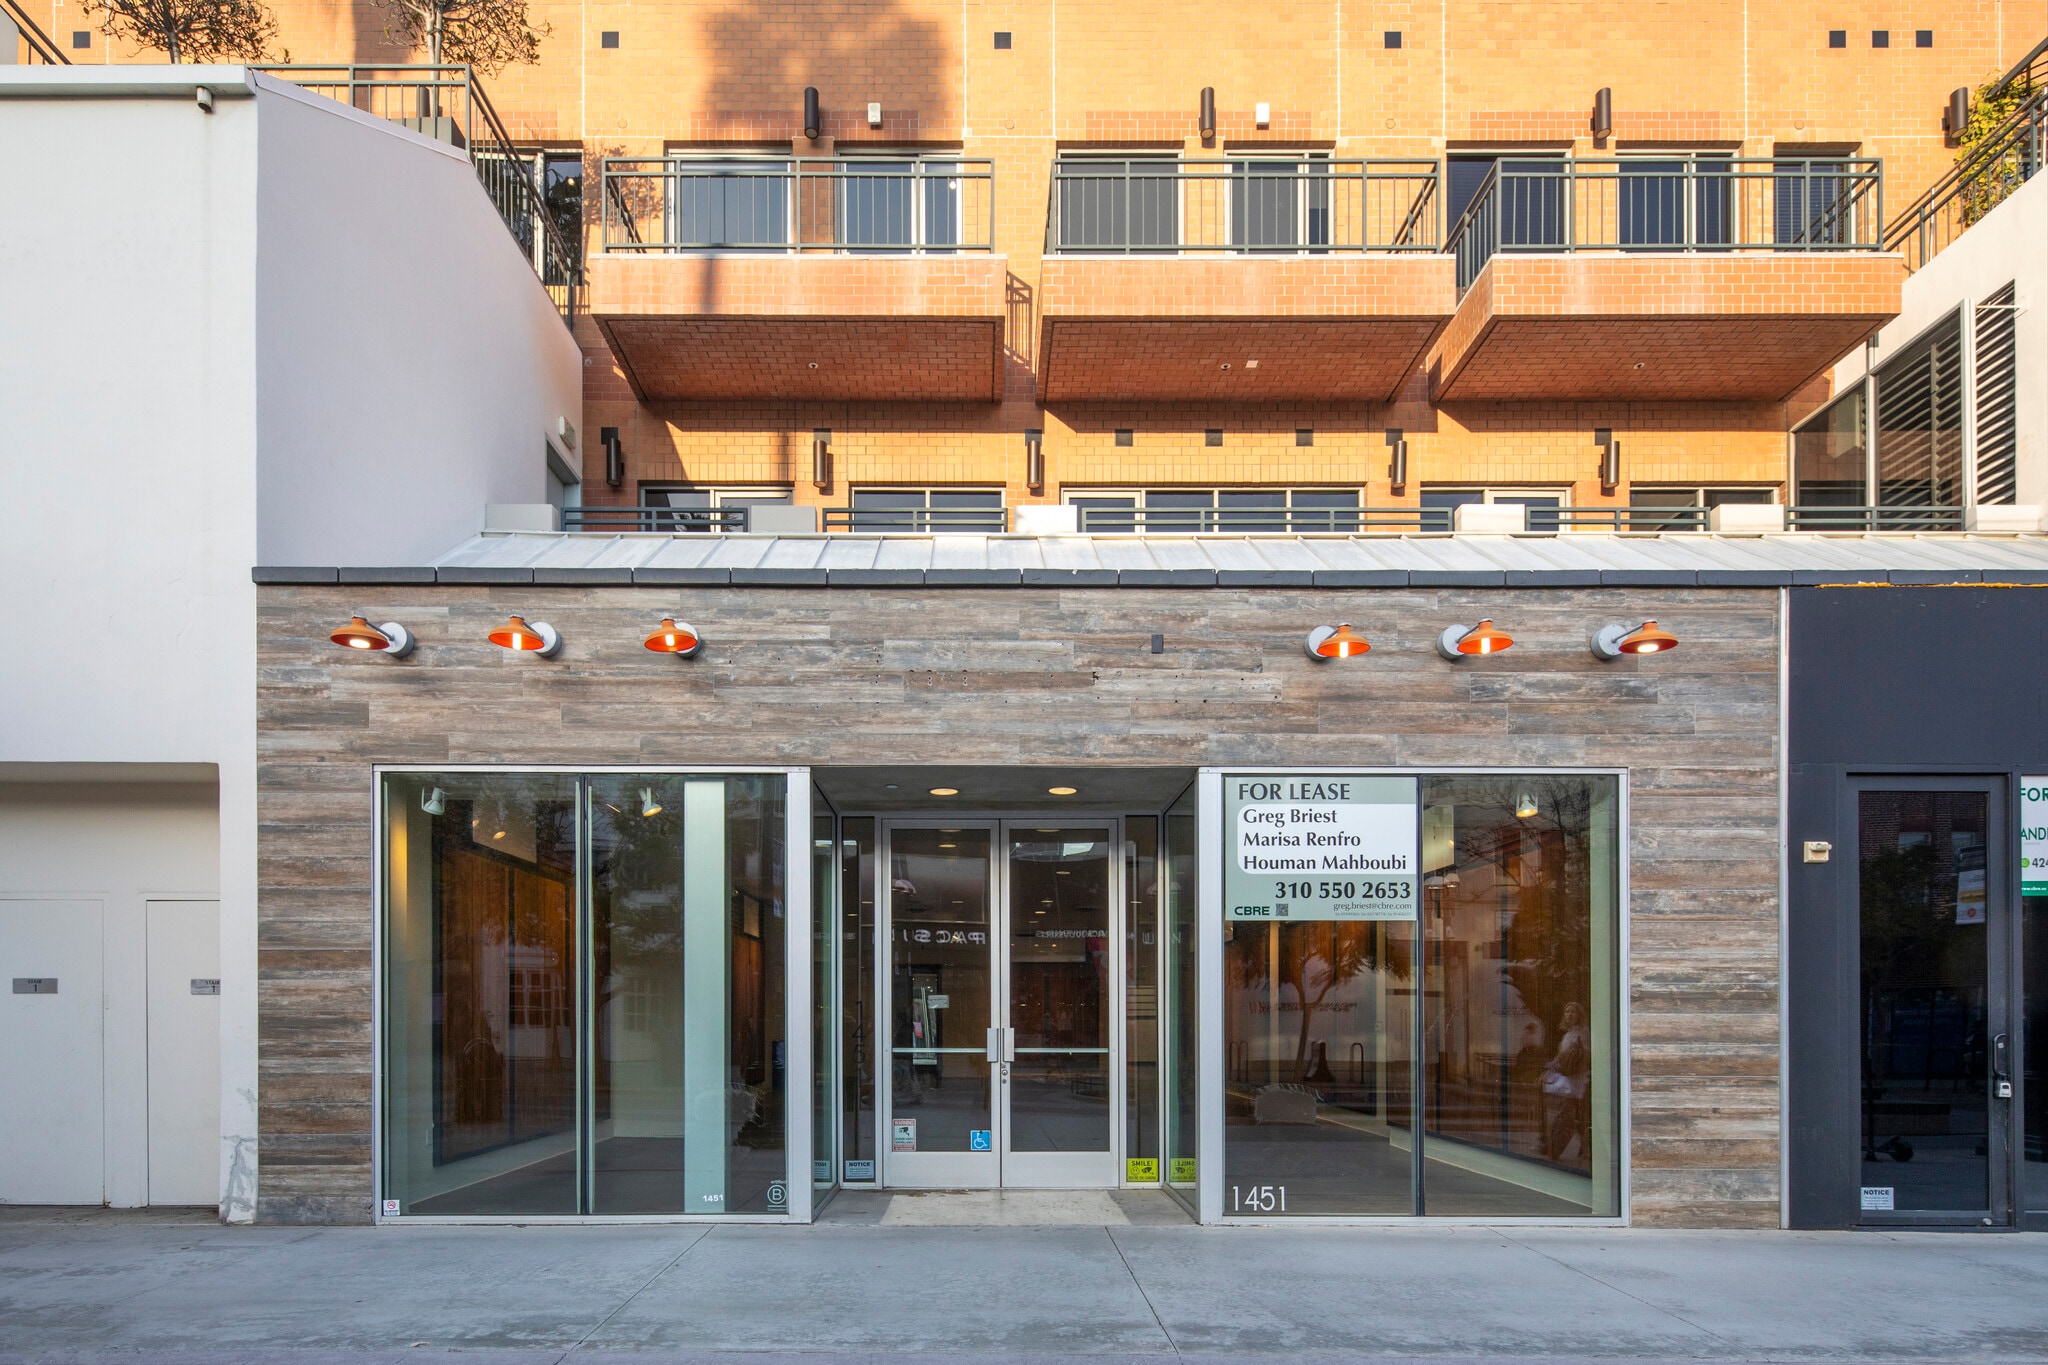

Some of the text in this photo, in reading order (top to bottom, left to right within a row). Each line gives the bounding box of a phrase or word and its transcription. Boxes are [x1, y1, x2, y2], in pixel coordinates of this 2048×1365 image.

[1238, 783, 1350, 801] FOR LEASE
[1243, 808, 1338, 828] Greg Briest
[1243, 831, 1361, 847] Marisa Renfro
[2021, 827, 2048, 841] AND
[1243, 855, 1407, 870] Houman Mahboubi
[1275, 881, 1411, 899] 310 550 2653
[1234, 906, 1270, 916] CBRE
[1333, 902, 1412, 911] greg.briest@cbre.com
[702, 1194, 724, 1203] 1451
[1232, 1186, 1286, 1211] 1451
